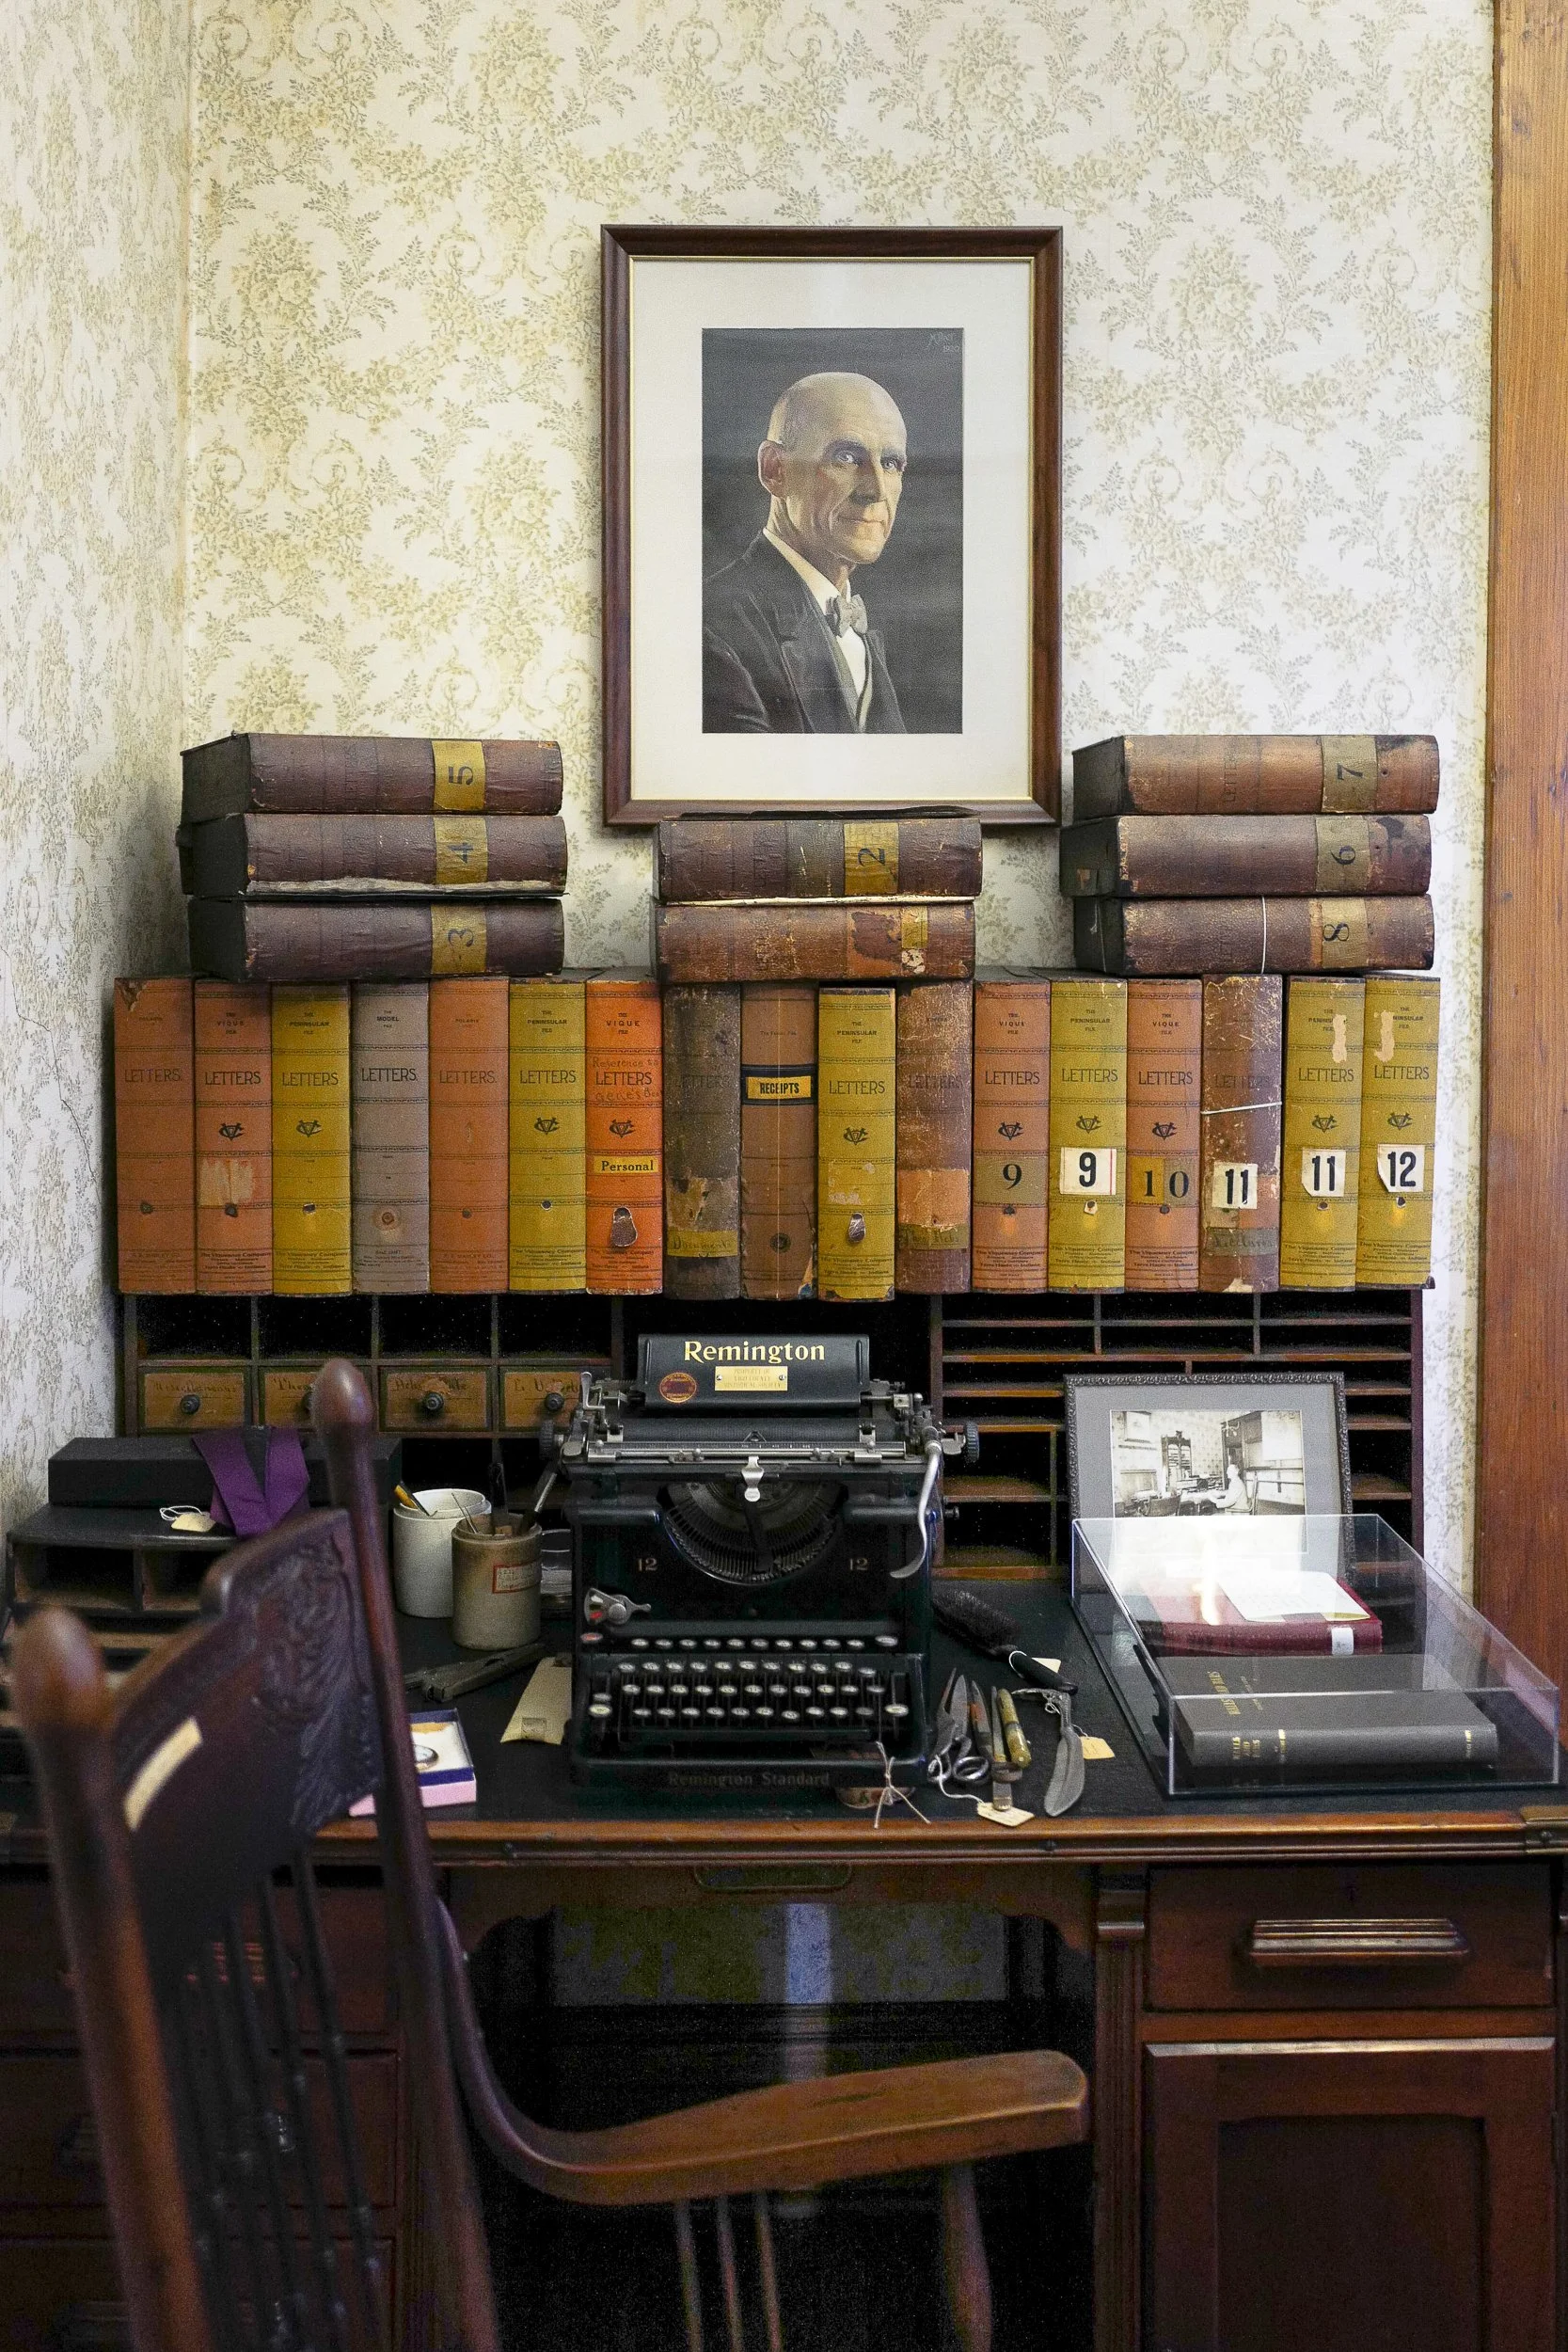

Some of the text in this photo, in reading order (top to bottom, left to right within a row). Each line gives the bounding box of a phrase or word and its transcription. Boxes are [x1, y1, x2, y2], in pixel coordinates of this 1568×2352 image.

[448, 765, 475, 786] 5
[1337, 763, 1363, 781] 7
[448, 842, 474, 864] 4
[858, 847, 886, 866] 2
[448, 928, 474, 947] 3
[1323, 923, 1350, 941] 8
[123, 1068, 182, 1082] LETTERS
[204, 1071, 261, 1086] LETTERS
[282, 1072, 339, 1087] LETTERS
[361, 1068, 418, 1083] LETTERS
[438, 1070, 496, 1084] LETTERS
[519, 1070, 577, 1085] LETTERS
[595, 1071, 653, 1086] LETTERS
[985, 1071, 1040, 1085] LETTERS
[1062, 1068, 1118, 1083] LETTERS
[1138, 1071, 1194, 1085] LETTERS
[1298, 1067, 1354, 1082] LETTERS
[1374, 1065, 1430, 1080] LETTERS
[759, 1082, 800, 1094] RECEIPTS
[829, 1081, 885, 1095] LETTERS
[601, 1159, 654, 1172] Personal
[1079, 1152, 1097, 1187] 9
[1387, 1151, 1417, 1187] 12
[1003, 1163, 1022, 1190] 9
[1311, 1155, 1336, 1192] 11
[1144, 1170, 1190, 1198] 10
[1225, 1169, 1250, 1204] 11
[684, 1341, 824, 1364] Remington
[638, 1558, 657, 1571] 12
[849, 1557, 868, 1571] 12
[668, 1772, 830, 1788] Remington Standard
